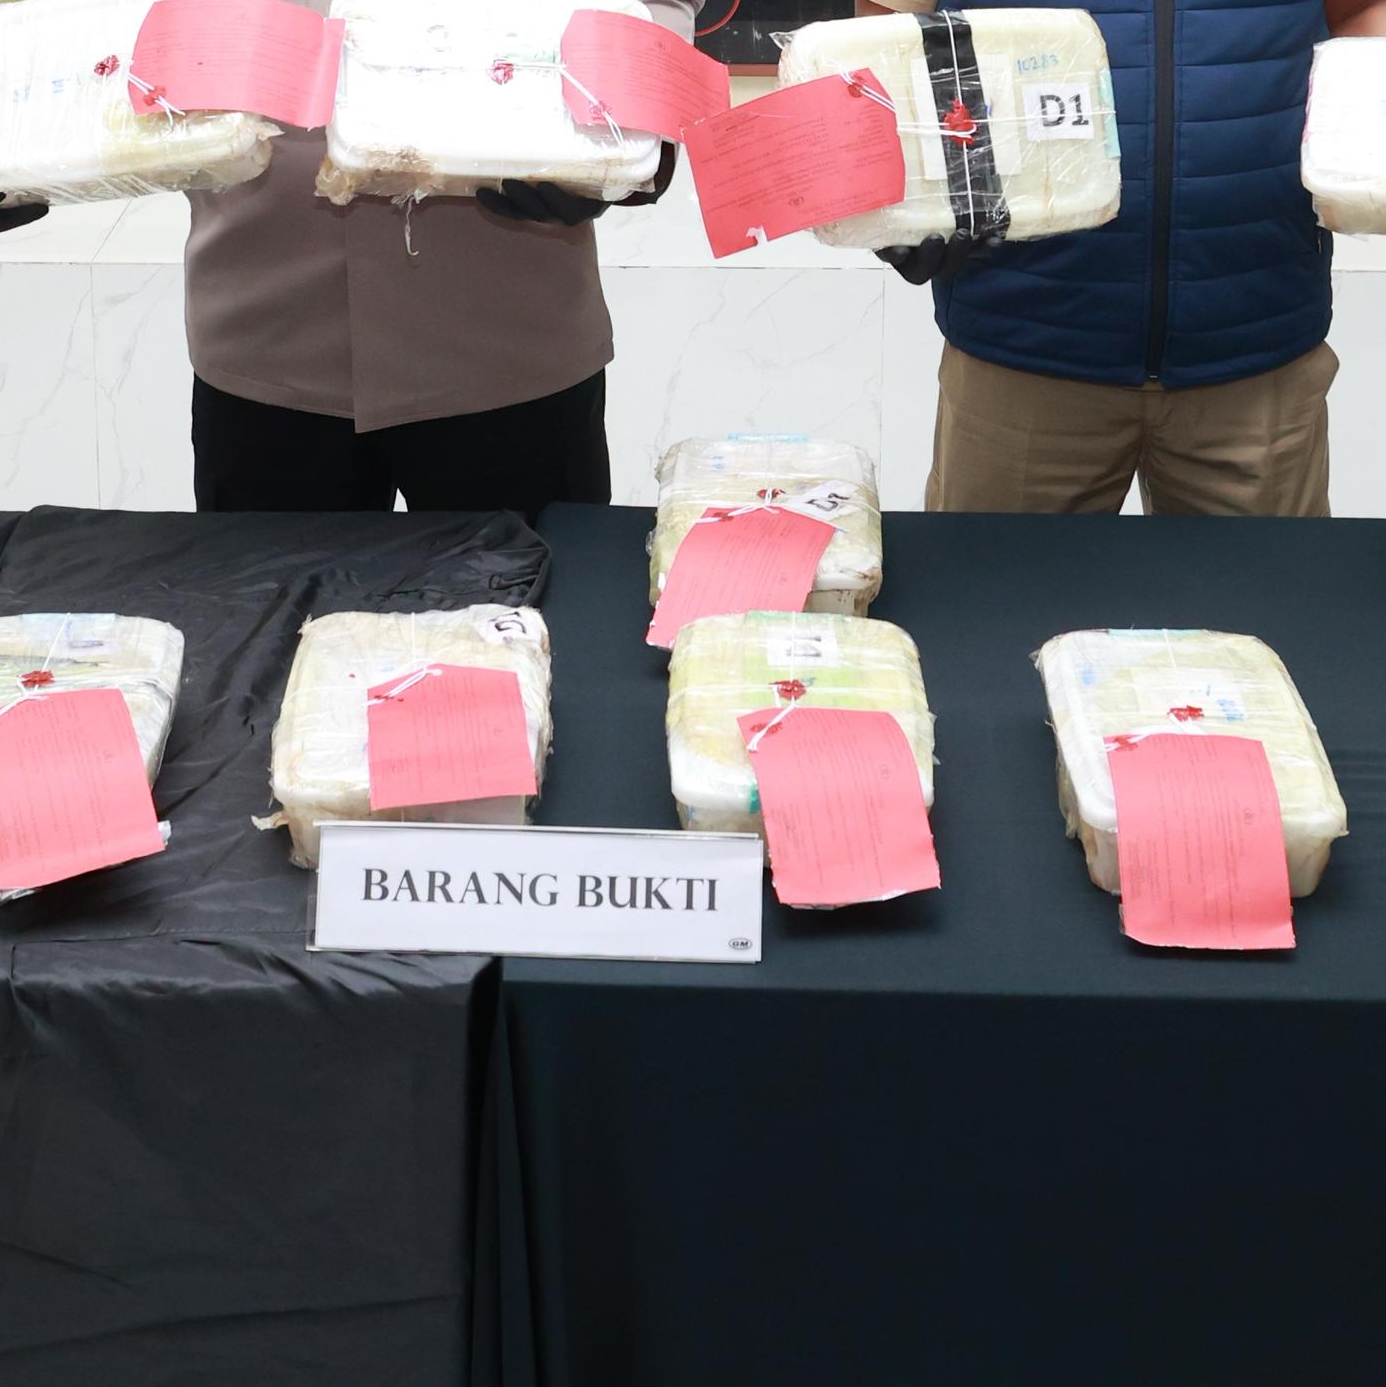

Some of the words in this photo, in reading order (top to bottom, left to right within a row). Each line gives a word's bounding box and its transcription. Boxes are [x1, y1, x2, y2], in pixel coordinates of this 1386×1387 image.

[1040, 94, 1089, 127] D1
[363, 868, 559, 907] BARANG
[577, 874, 719, 911] BUKTI
